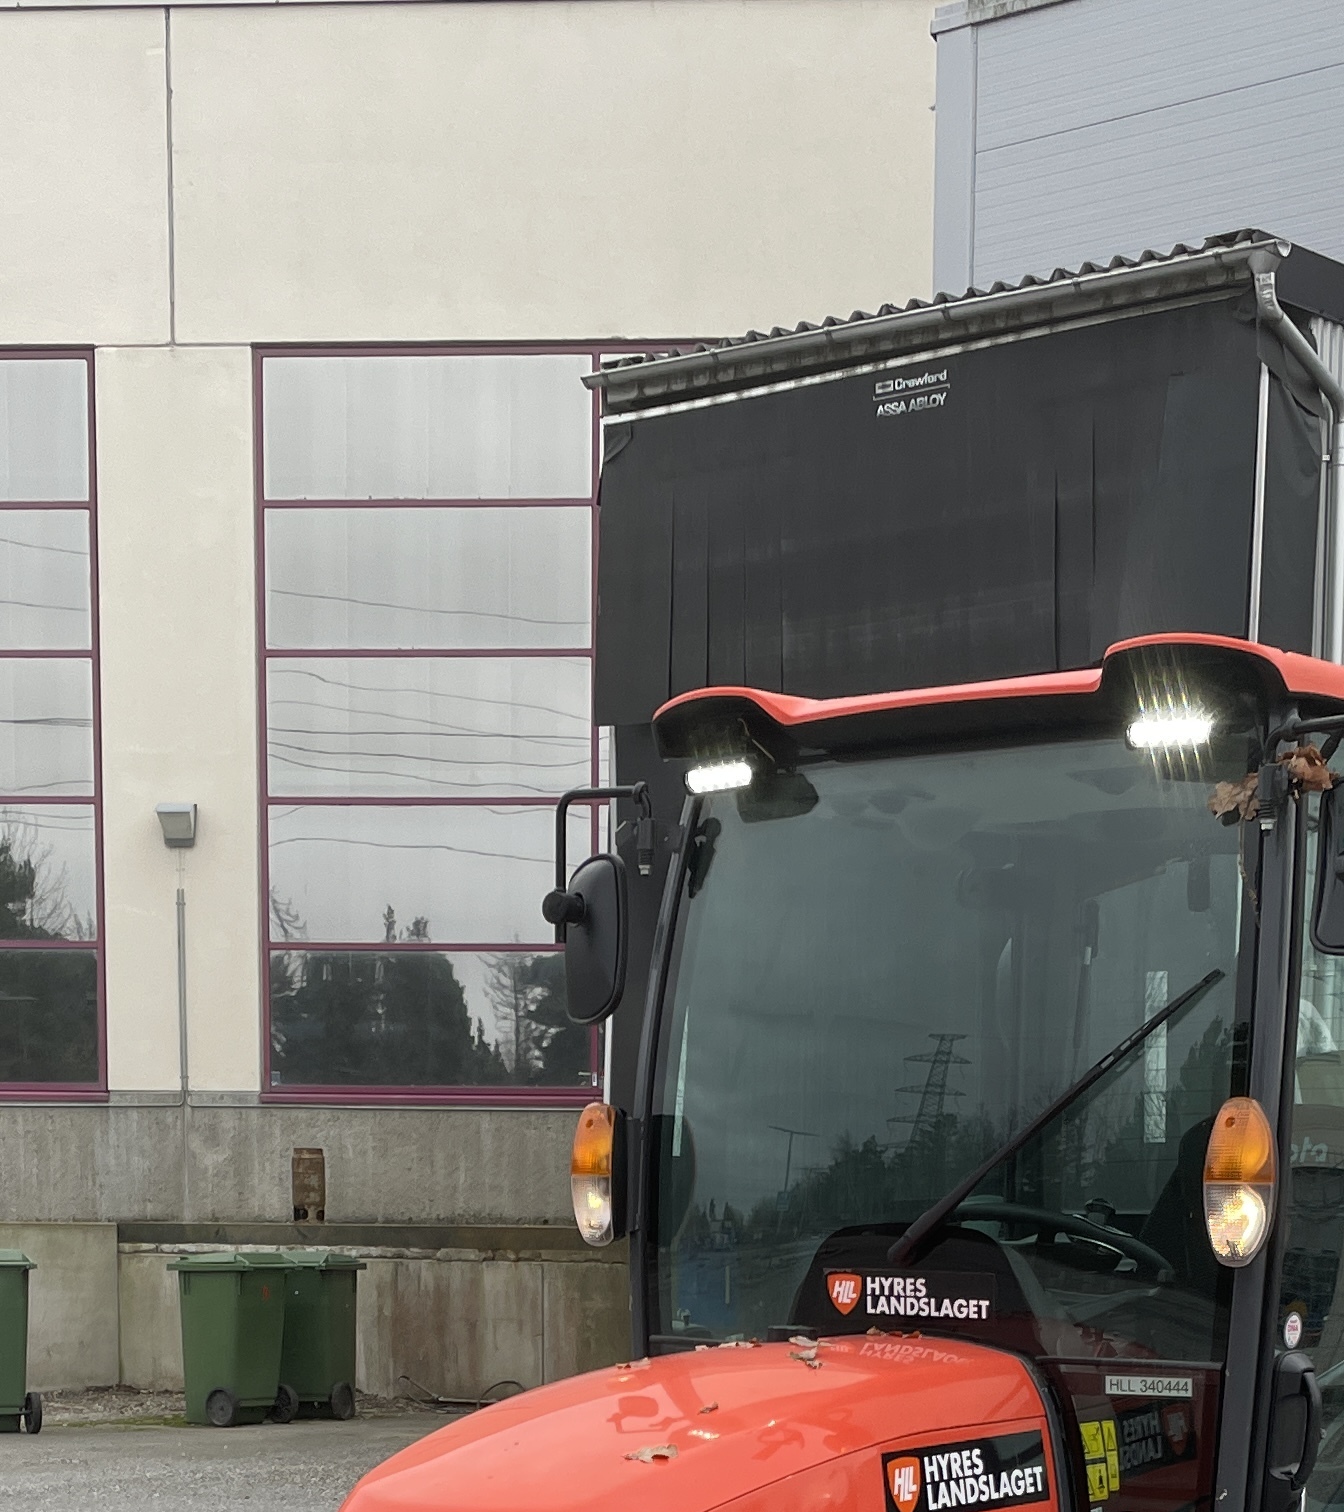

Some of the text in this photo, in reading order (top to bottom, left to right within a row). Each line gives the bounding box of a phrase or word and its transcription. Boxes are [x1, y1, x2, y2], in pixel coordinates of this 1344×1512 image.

[894, 369, 948, 391] Crawford
[876, 391, 947, 418] ASSA ABLOY
[832, 1279, 857, 1304] HLL
[865, 1275, 927, 1298] HYRES
[865, 1296, 990, 1320] LANDSLAGET
[1108, 1378, 1190, 1394] HLL 340444
[923, 1448, 984, 1484] HYRES
[893, 1466, 917, 1503] HLL
[926, 1465, 1044, 1511] LANDSLAGET
